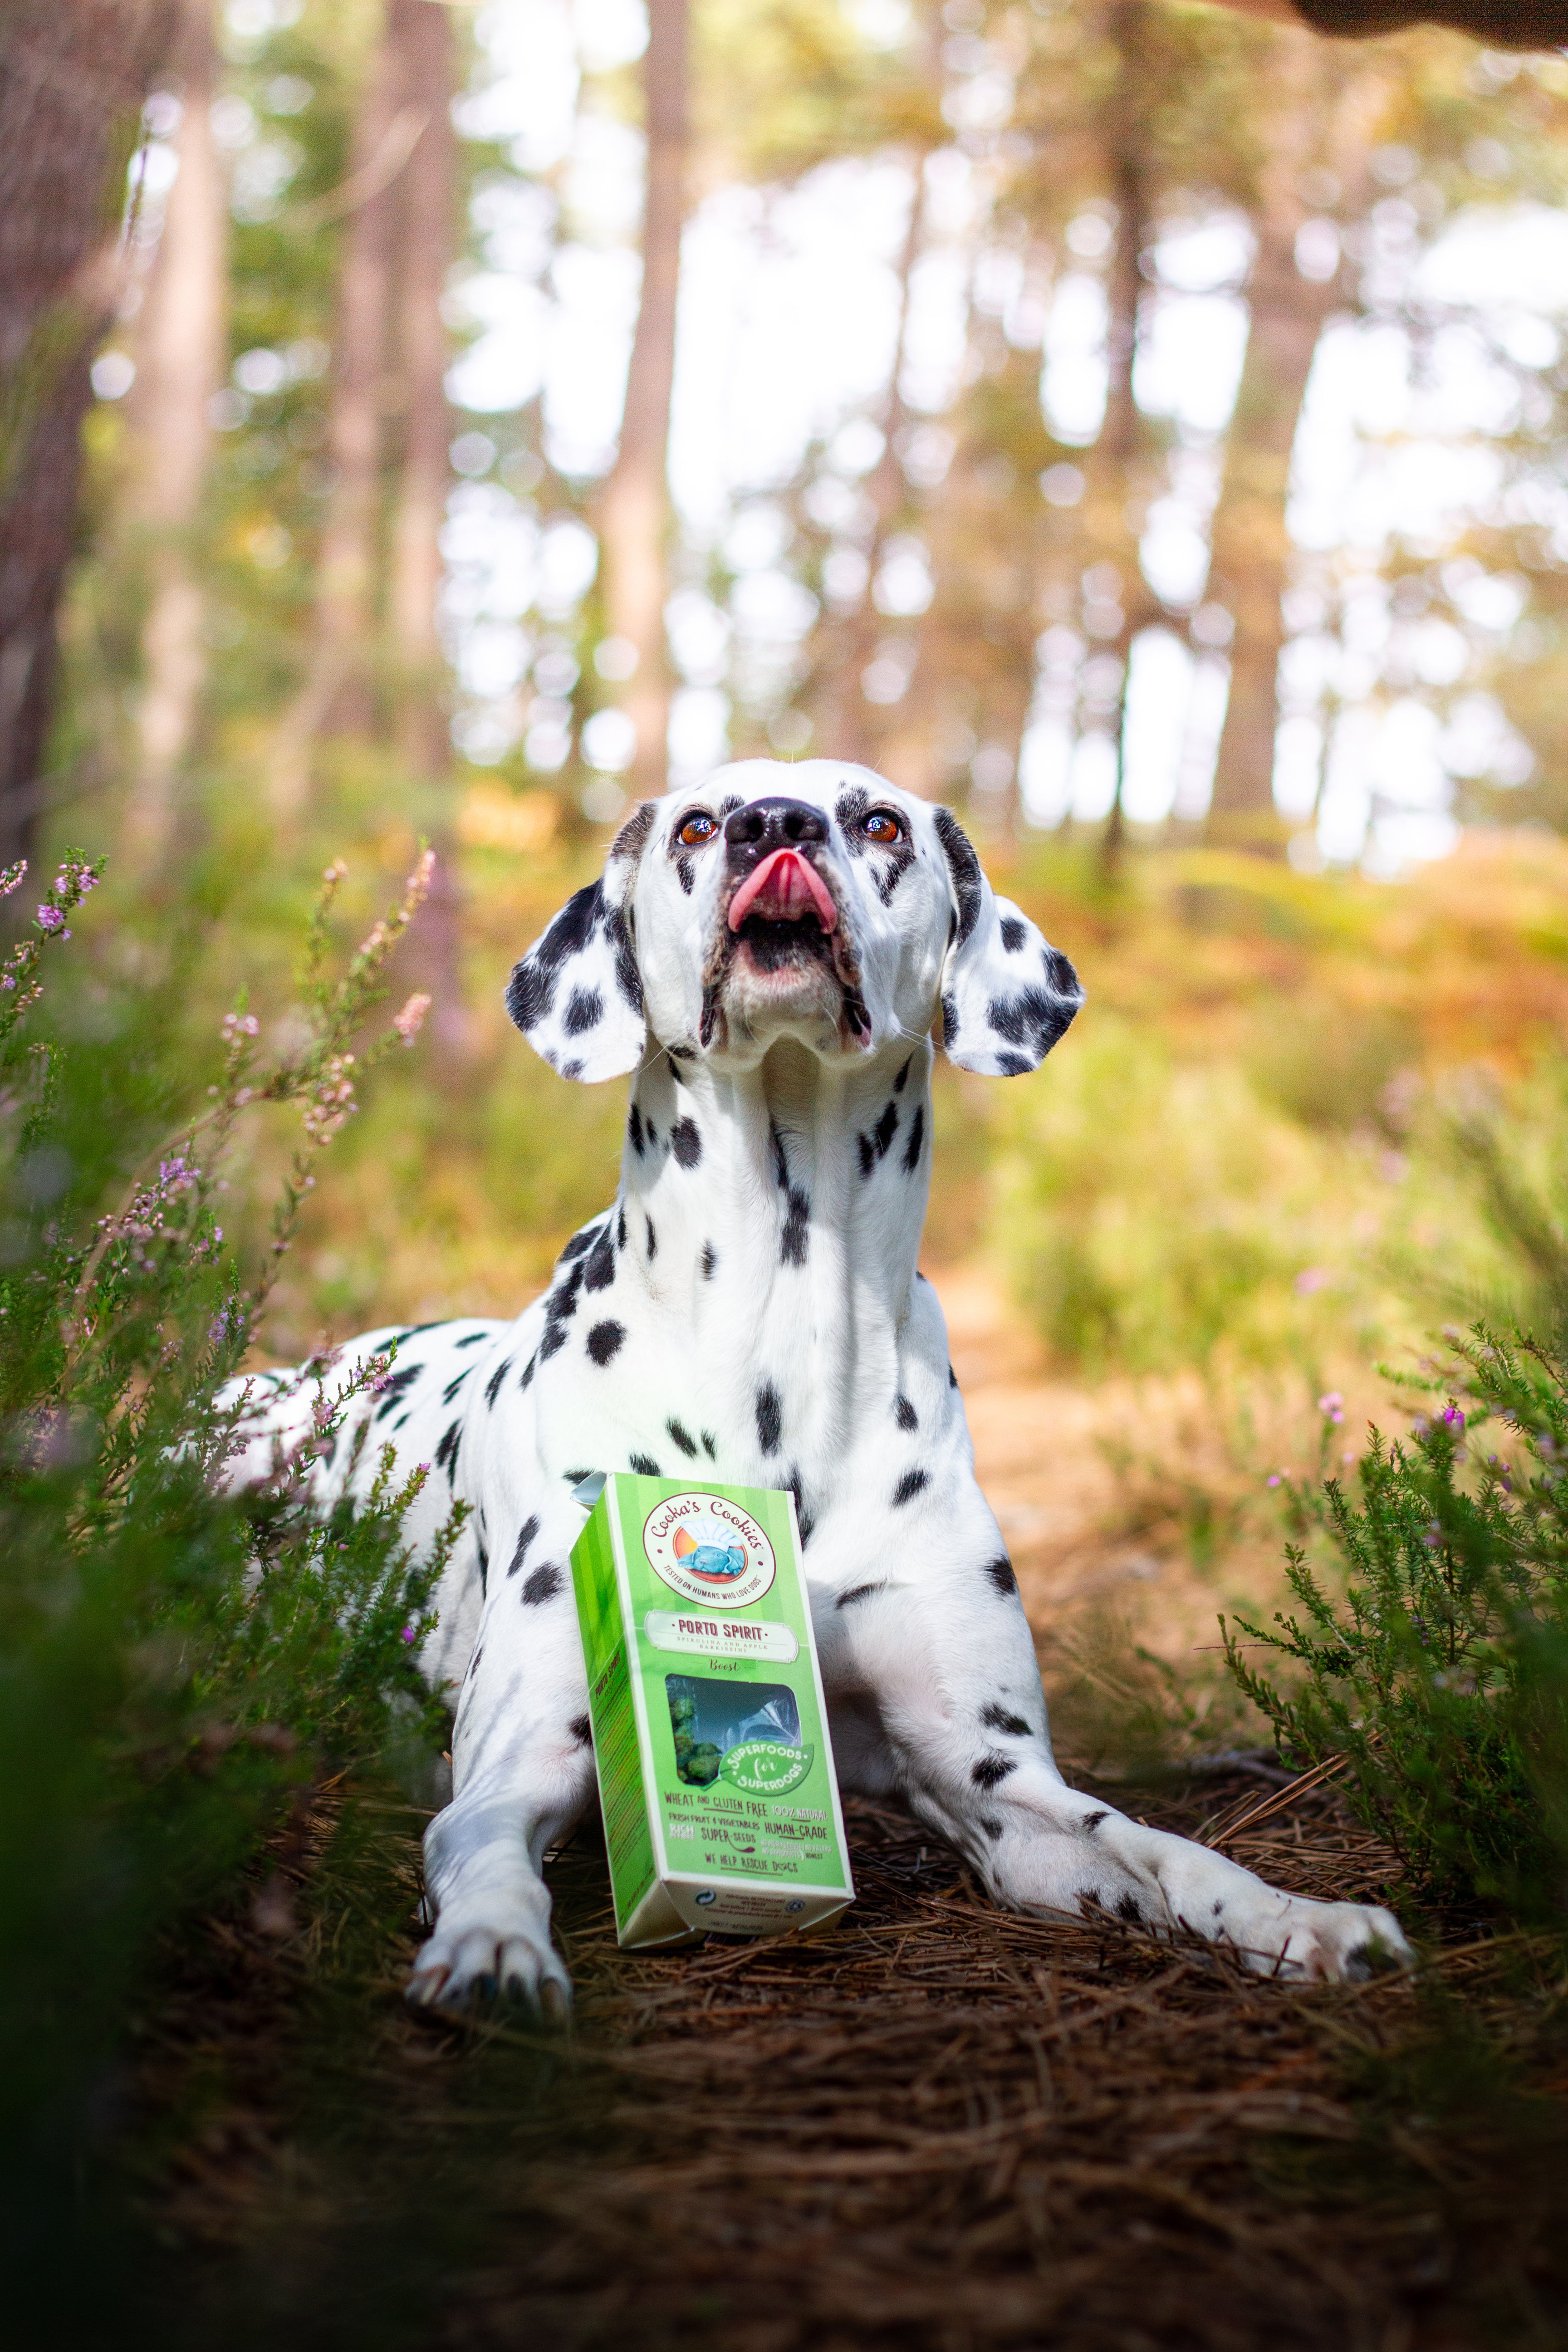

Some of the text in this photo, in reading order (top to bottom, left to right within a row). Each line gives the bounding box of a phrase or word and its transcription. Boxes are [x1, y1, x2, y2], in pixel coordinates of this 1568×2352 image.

[651, 1500, 762, 1550] Cooka's Cookies
[663, 1565, 682, 1584] TESTED
[682, 1581, 691, 1590] ON
[692, 1587, 720, 1600] HUMANS
[737, 1587, 751, 1597] LOVE
[750, 1577, 761, 1591] DOGS
[678, 1619, 763, 1641] PORTO SPIRIT
[677, 1637, 720, 1645] SPIRULINA
[709, 1659, 741, 1671] Boost
[727, 1744, 802, 1769] SUPERFOODS
[737, 1763, 803, 1790] SUPERDOGS
[664, 1792, 767, 1818] WHEAT AND GLUTEN FREE
[772, 1804, 828, 1822] 100% NATURAL
[668, 1812, 690, 1822] FRESH
[691, 1814, 710, 1824] FRUIT
[718, 1817, 760, 1831] VEGETABLES
[764, 1822, 828, 1840] HUMAN-GRADE
[705, 1852, 715, 1864] WE
[720, 1854, 736, 1866] HELP
[741, 1857, 768, 1871] RESCUE
